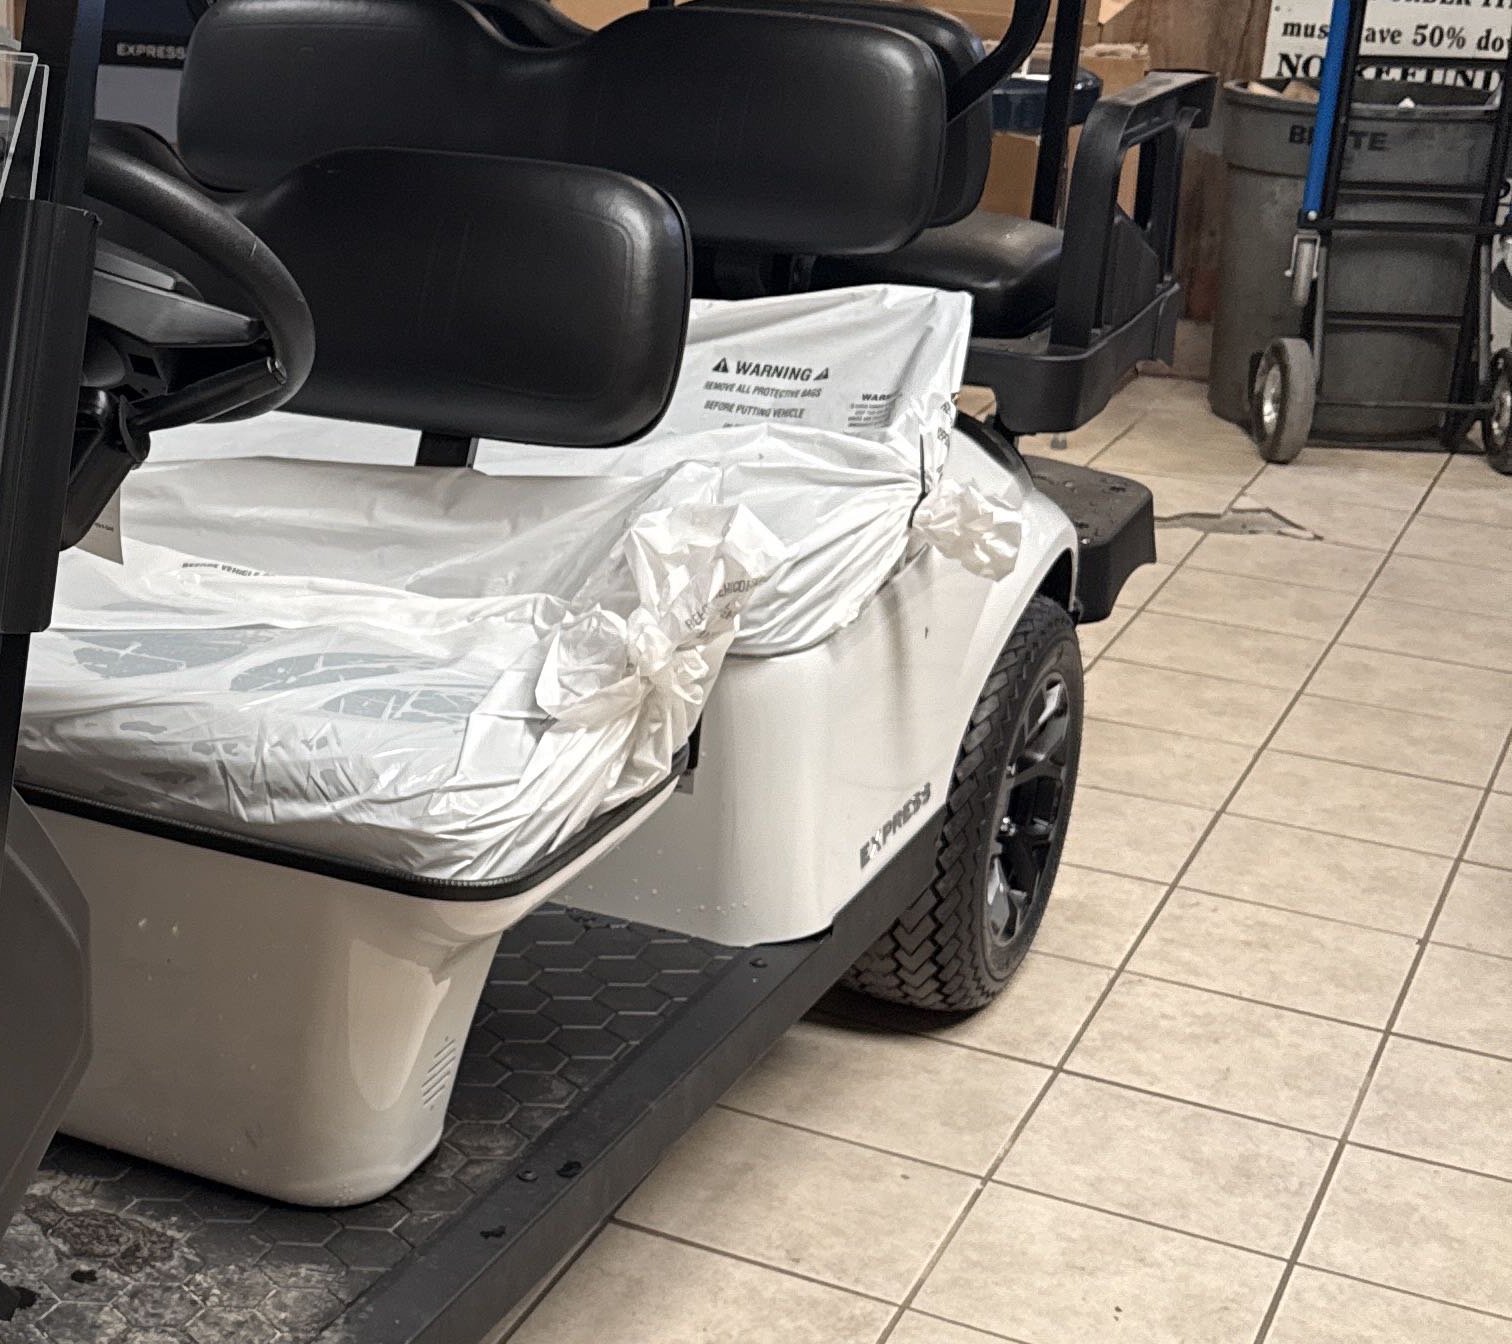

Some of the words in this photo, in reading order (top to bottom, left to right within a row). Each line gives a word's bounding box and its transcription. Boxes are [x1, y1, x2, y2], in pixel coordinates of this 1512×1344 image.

[1282, 21, 1329, 39] mus
[1365, 25, 1402, 45] ave
[1412, 24, 1466, 50] 50%
[1289, 124, 1387, 152] BTE
[735, 360, 813, 382] WARNING
[703, 381, 736, 393] REMOVE
[736, 384, 751, 395] ALL
[752, 386, 800, 399] PROTECTIVE
[703, 400, 736, 413] BEFORE
[736, 404, 771, 418] PUTTING
[772, 408, 806, 419] VEHICLE
[859, 782, 931, 868] EXPRESS
